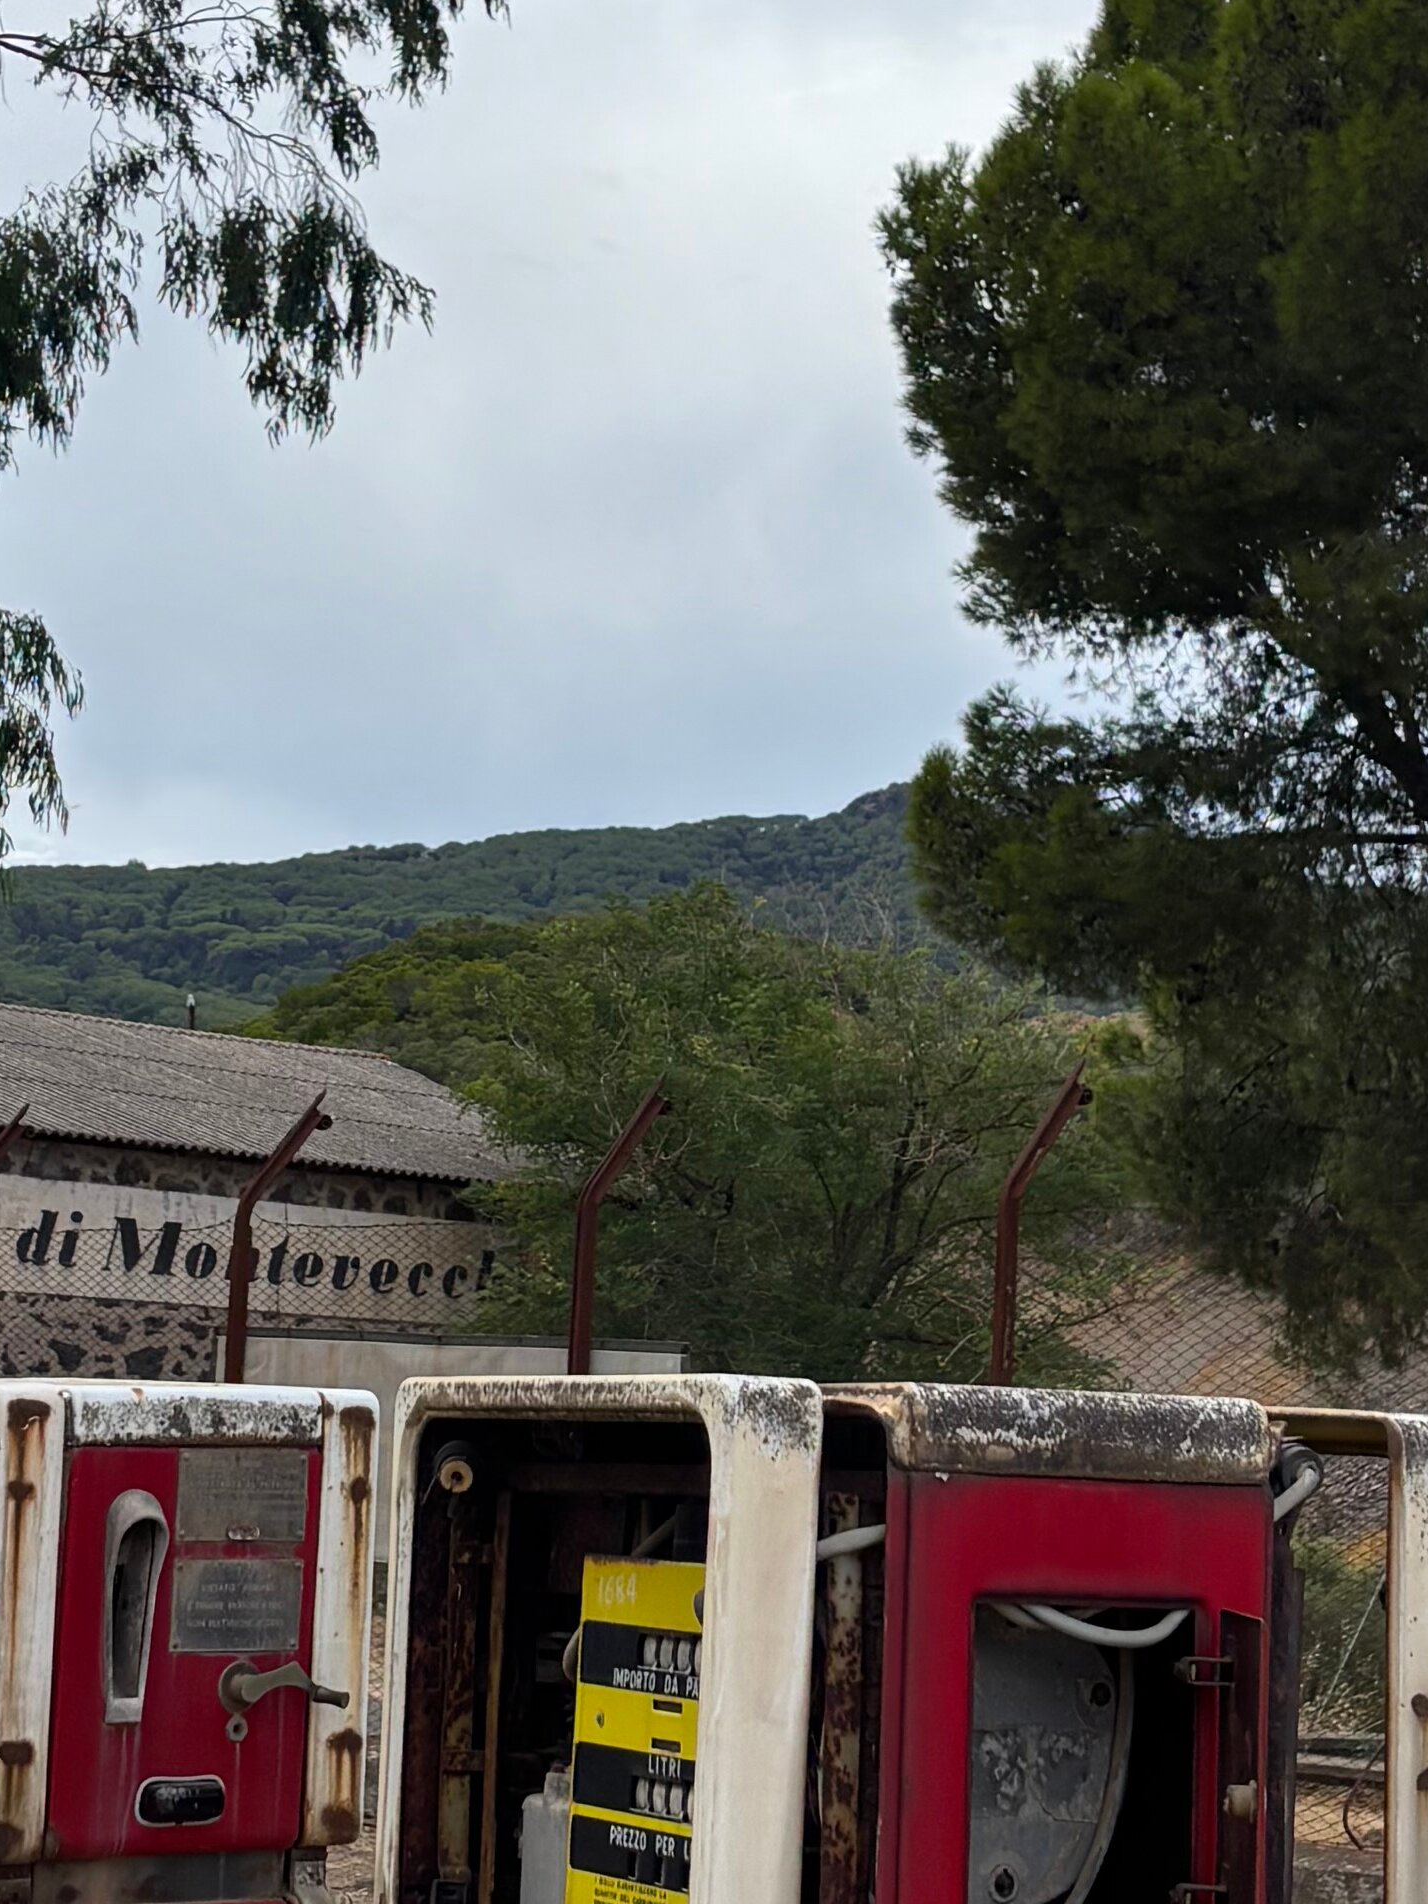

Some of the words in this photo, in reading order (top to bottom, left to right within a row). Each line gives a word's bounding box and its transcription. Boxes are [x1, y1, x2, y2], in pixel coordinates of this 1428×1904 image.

[16, 1209, 84, 1267] di
[100, 1216, 495, 1299] Motevecc
[612, 1667, 657, 1692] IMPORTO
[663, 1674, 679, 1695] DA
[648, 1753, 681, 1779] LITRI
[609, 1824, 647, 1852] PREZZO
[655, 1834, 676, 1858] PER
